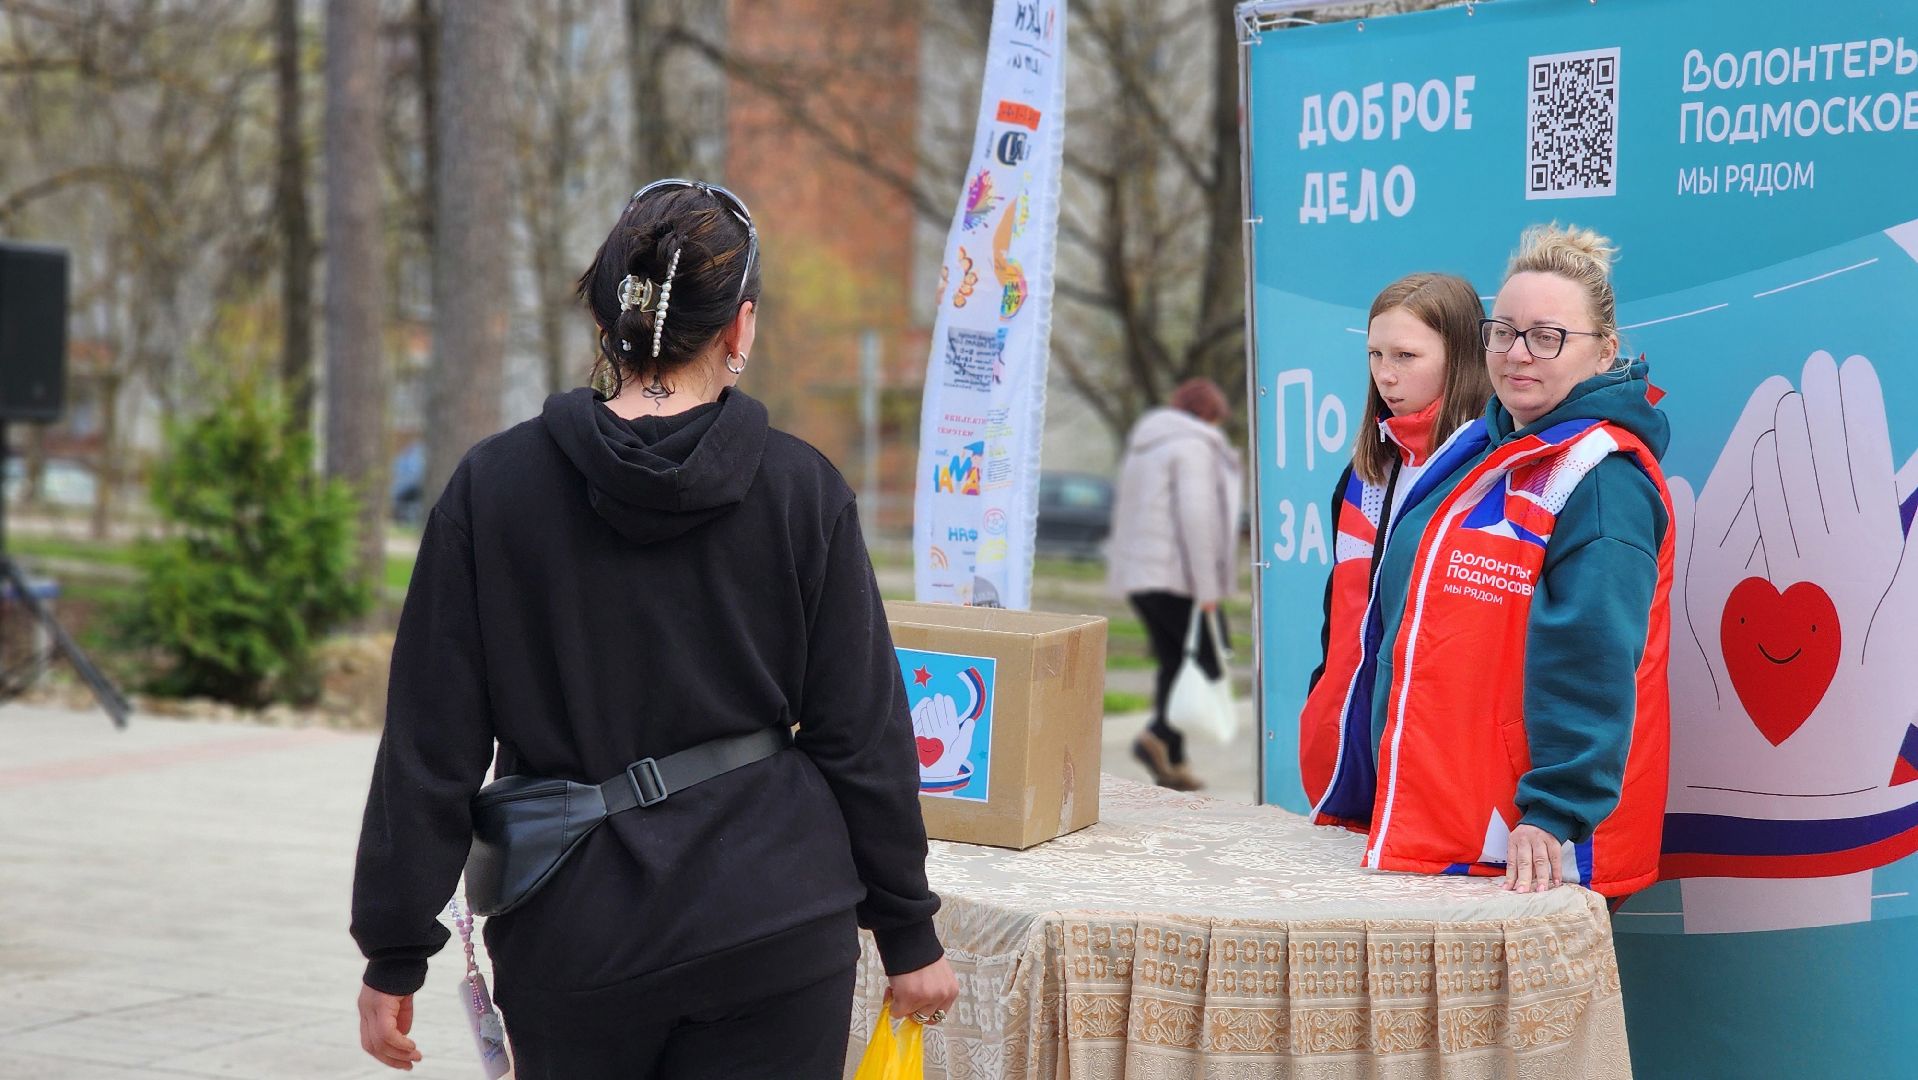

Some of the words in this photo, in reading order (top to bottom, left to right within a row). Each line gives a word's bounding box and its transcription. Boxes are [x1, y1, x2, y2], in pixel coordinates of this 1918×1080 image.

[1298, 75, 1476, 150] ДОБРОЕ
[1299, 164, 1416, 224] ДЕЛО
[1678, 166, 1719, 195] МЫ
[1725, 161, 1814, 197] РЯДОМ
[1443, 584, 1461, 595] МЫ
[1463, 586, 1503, 605] РЯДОМ
